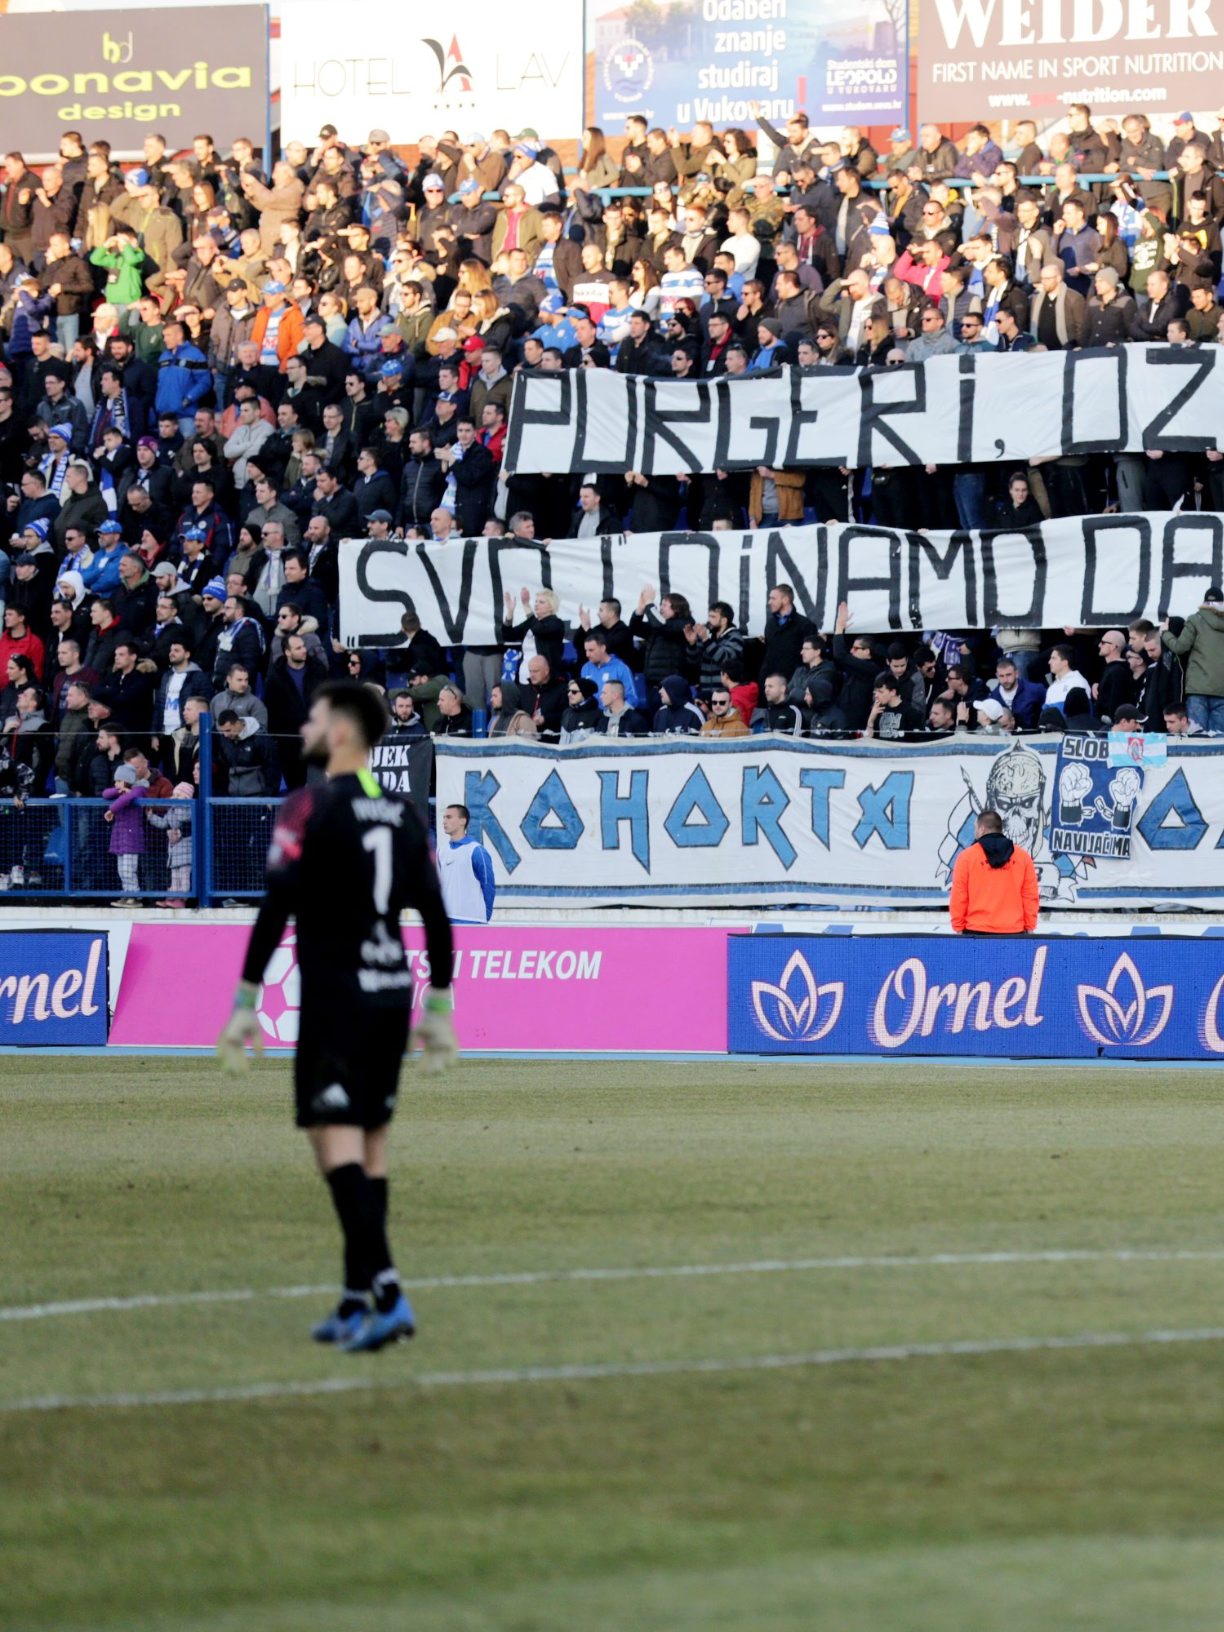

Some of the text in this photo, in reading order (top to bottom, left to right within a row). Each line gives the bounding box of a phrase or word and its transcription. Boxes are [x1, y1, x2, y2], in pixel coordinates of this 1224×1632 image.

[714, 24, 786, 57] znanje
[932, 0, 1219, 49] WEIDER
[293, 57, 411, 97] HOTEL
[497, 50, 570, 91] LAV
[697, 60, 779, 92] studiraj
[932, 50, 1224, 83] FIRST NAME IN SPORT NUTRITION
[57, 101, 181, 122] design
[676, 102, 691, 124] u
[463, 762, 915, 875] KOHORTA
[362, 825, 393, 916] 1
[470, 950, 603, 980] TELEKOM
[872, 945, 1048, 1048] Ornel
